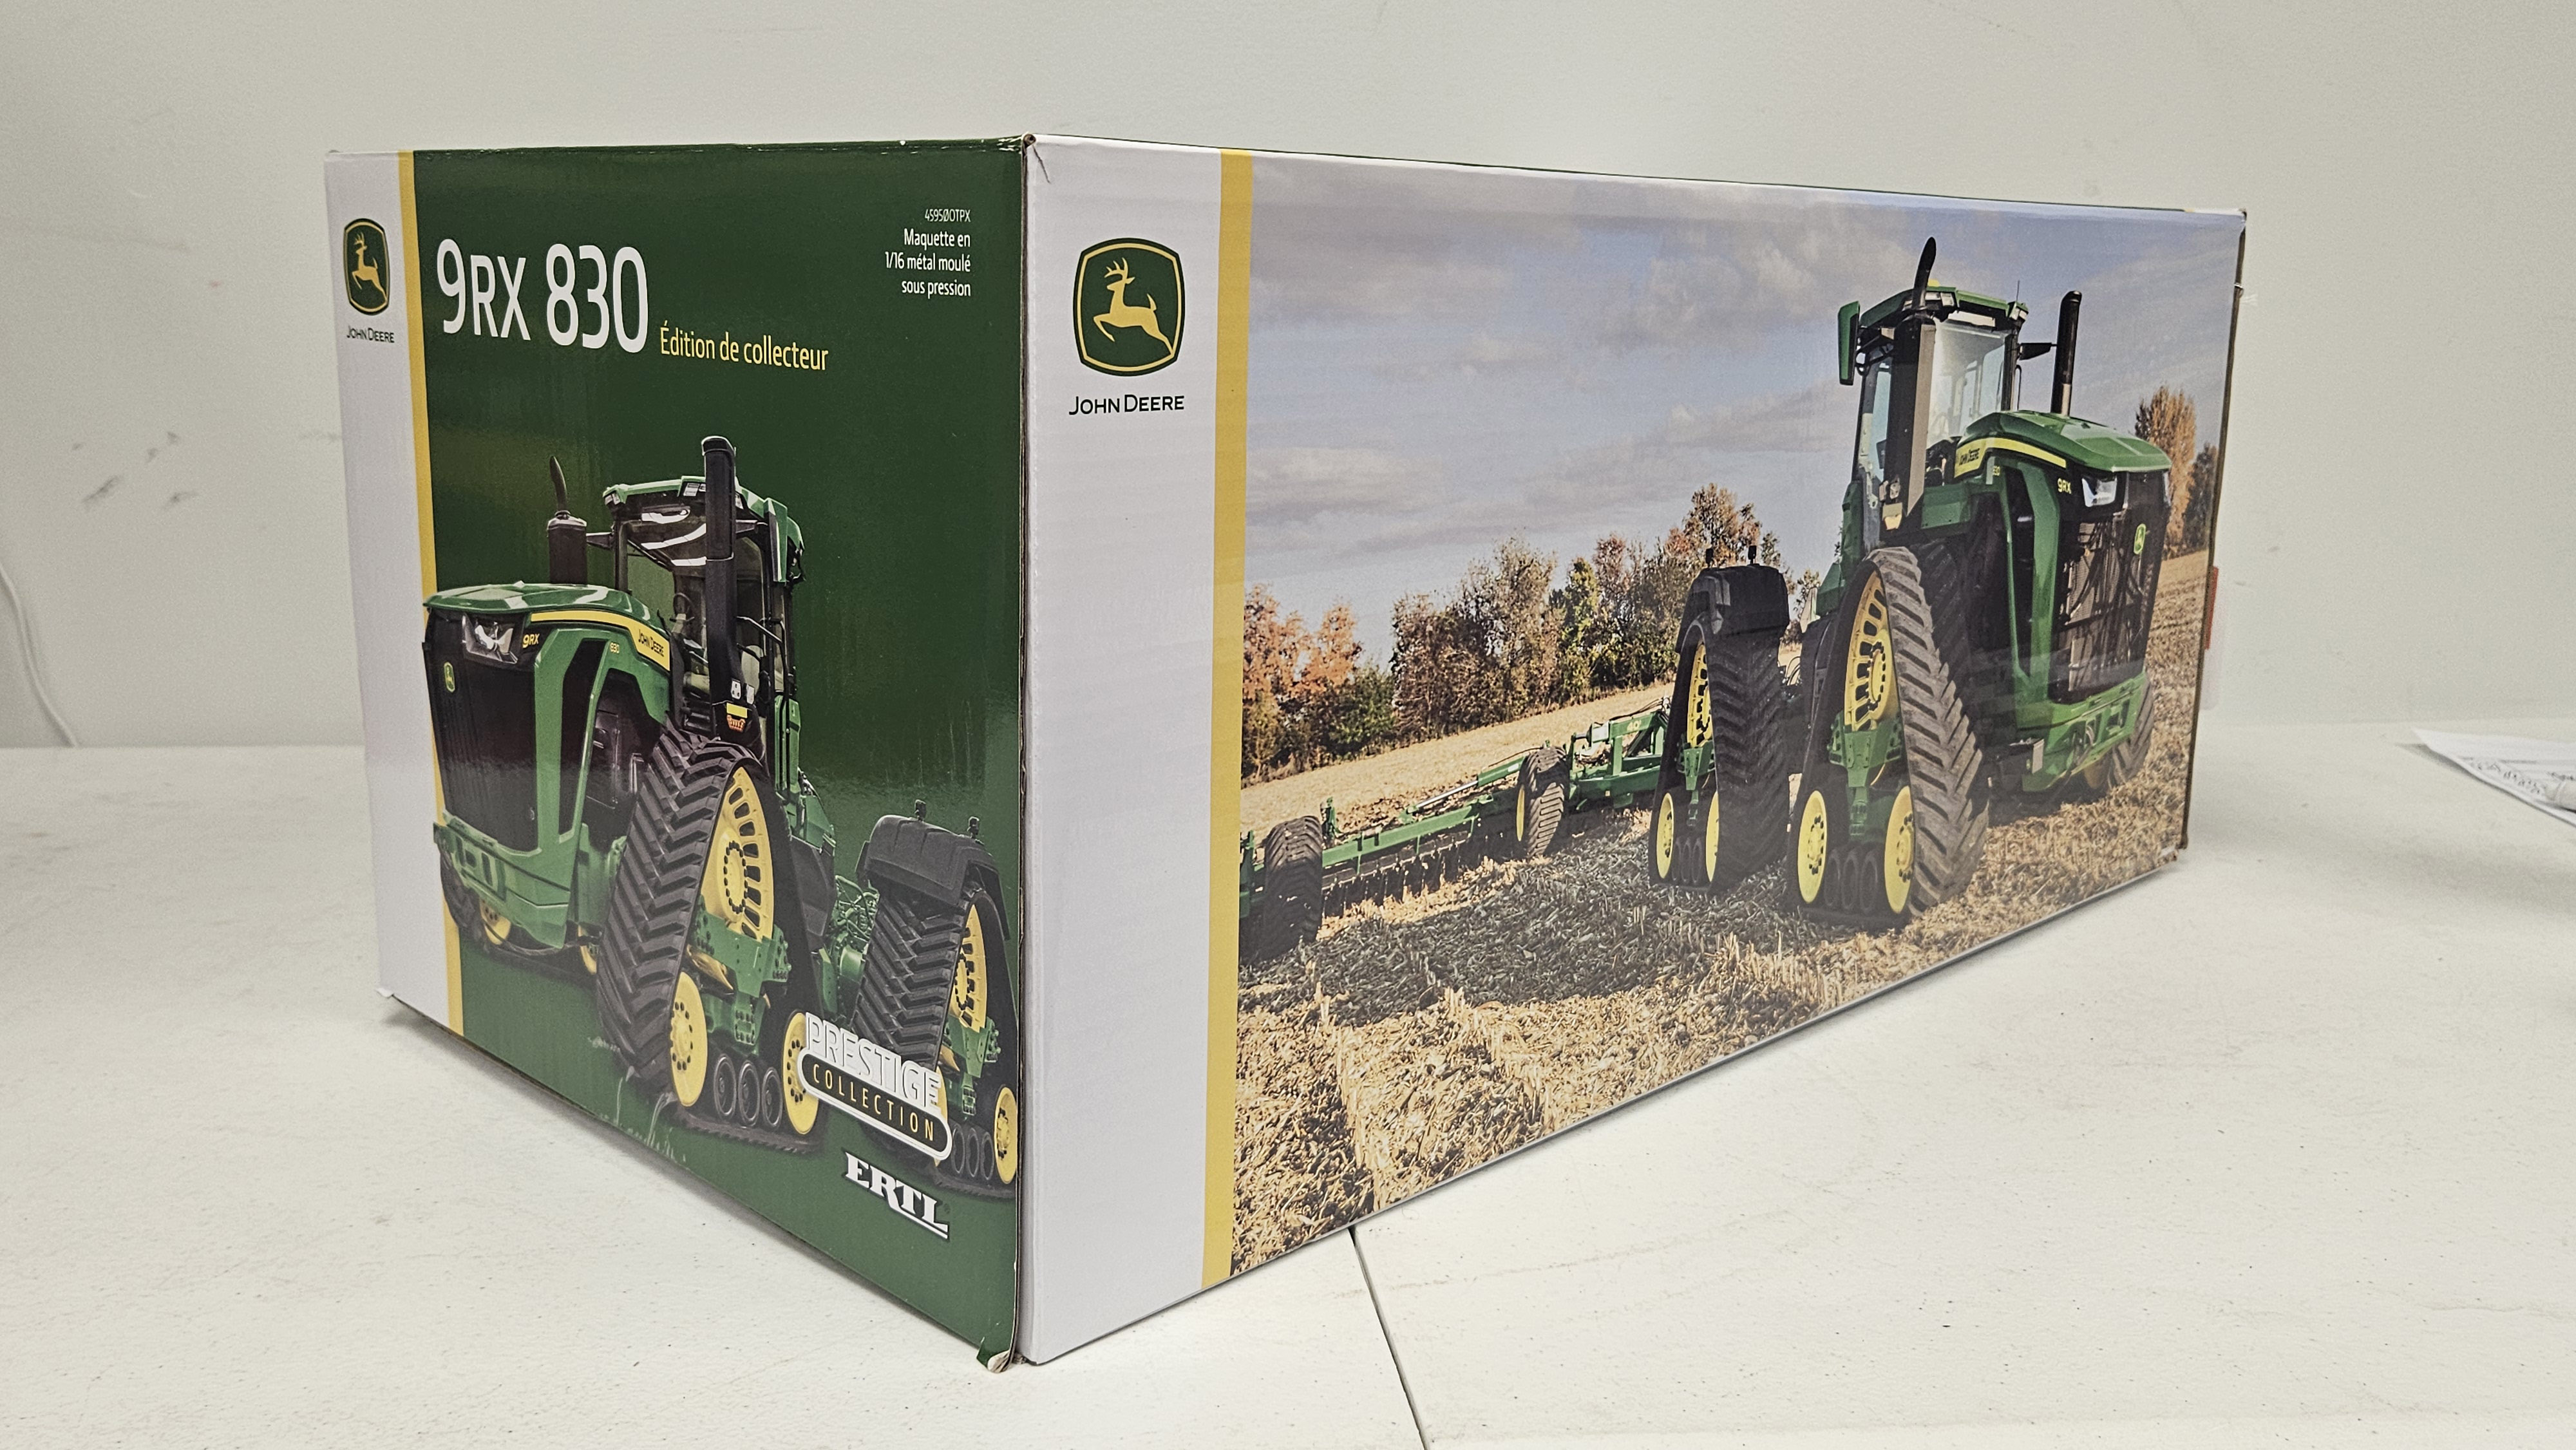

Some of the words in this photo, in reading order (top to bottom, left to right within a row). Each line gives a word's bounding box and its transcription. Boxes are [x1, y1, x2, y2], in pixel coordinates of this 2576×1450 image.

[904, 228, 955, 250] Maquette
[958, 234, 971, 247] en
[885, 251, 905, 269] 1/16
[907, 253, 936, 270] métal
[938, 254, 971, 272] moulé
[437, 239, 531, 341] 9RX
[546, 243, 649, 353] 830
[902, 281, 925, 294] sous
[927, 279, 971, 299] pression
[660, 320, 715, 359] Édition
[719, 332, 739, 362] de
[744, 335, 829, 370] collecteur
[1068, 396, 1120, 415] JOHN
[1124, 394, 1184, 413] DEERE
[522, 633, 540, 648] 9RX
[806, 1012, 942, 1115] PRESTIGE
[813, 1063, 934, 1142] COLLECTION
[845, 1151, 949, 1239] ERTL
